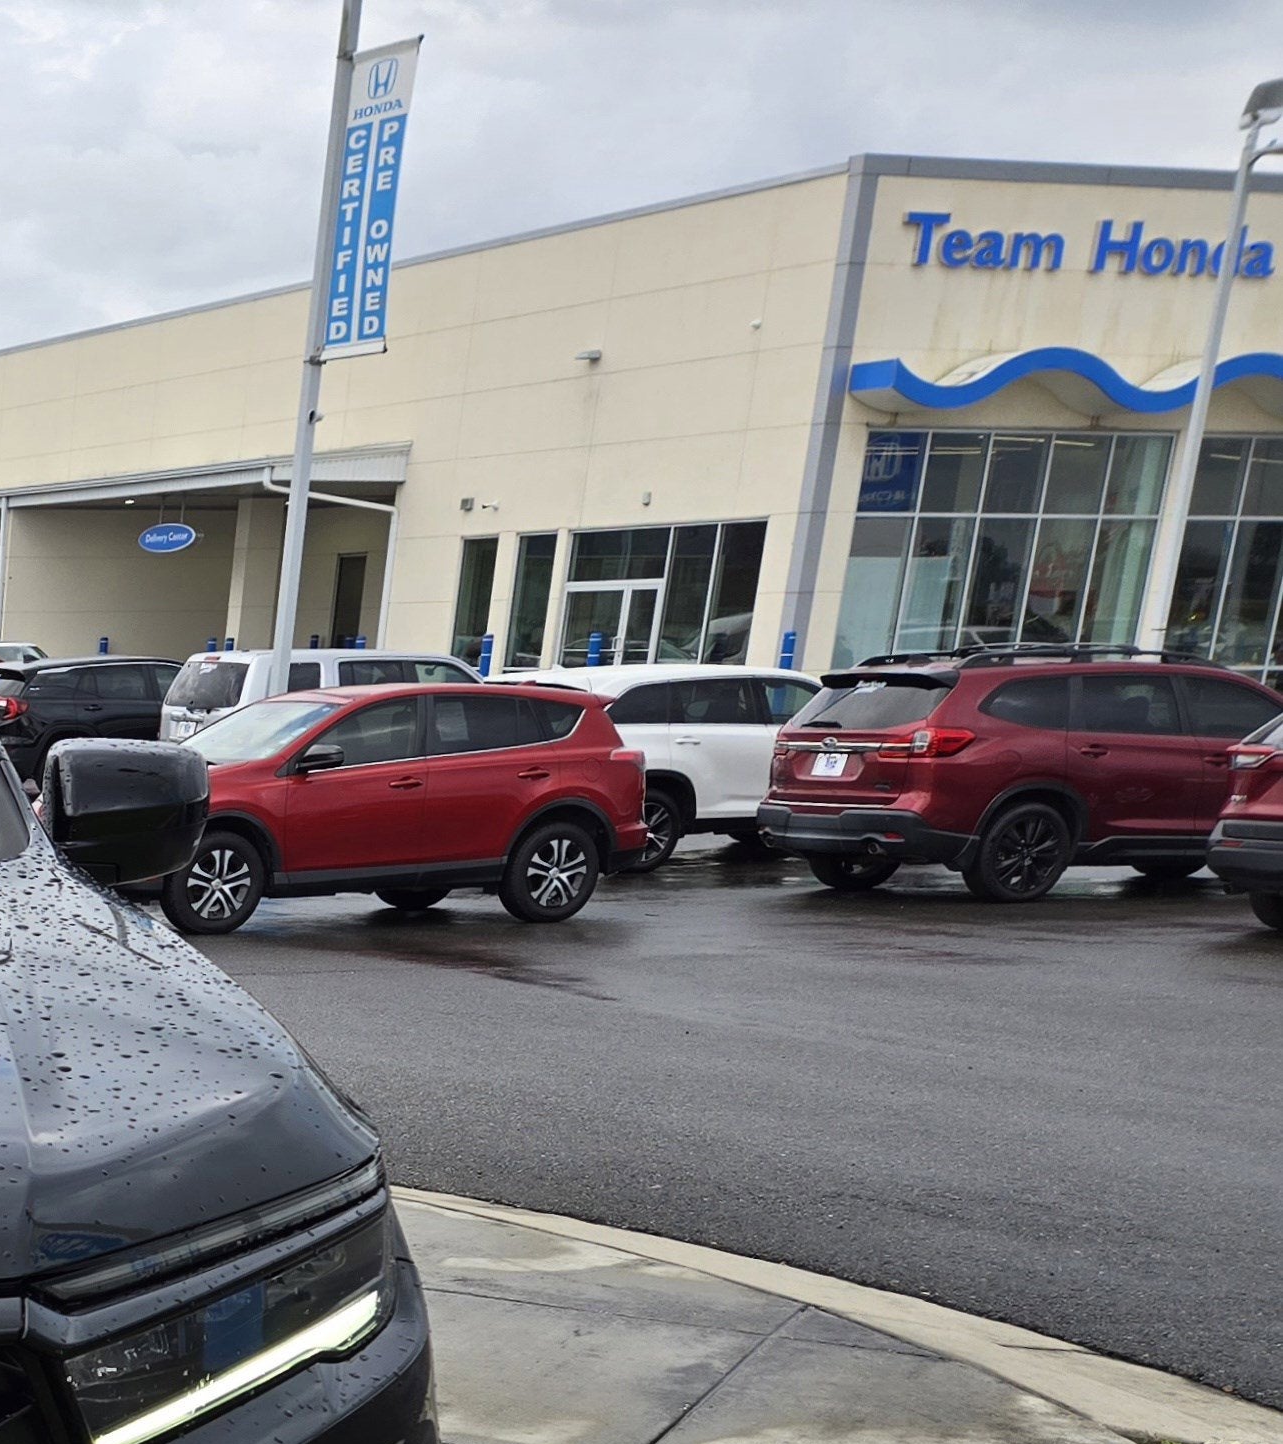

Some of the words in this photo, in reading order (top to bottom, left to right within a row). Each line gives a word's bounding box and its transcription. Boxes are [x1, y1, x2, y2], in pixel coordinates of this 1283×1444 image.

[353, 98, 403, 121] HONDA
[375, 121, 400, 192] PRE
[328, 130, 368, 341] CERTIFIED
[904, 211, 1066, 273] Team
[363, 219, 389, 336] OWNED
